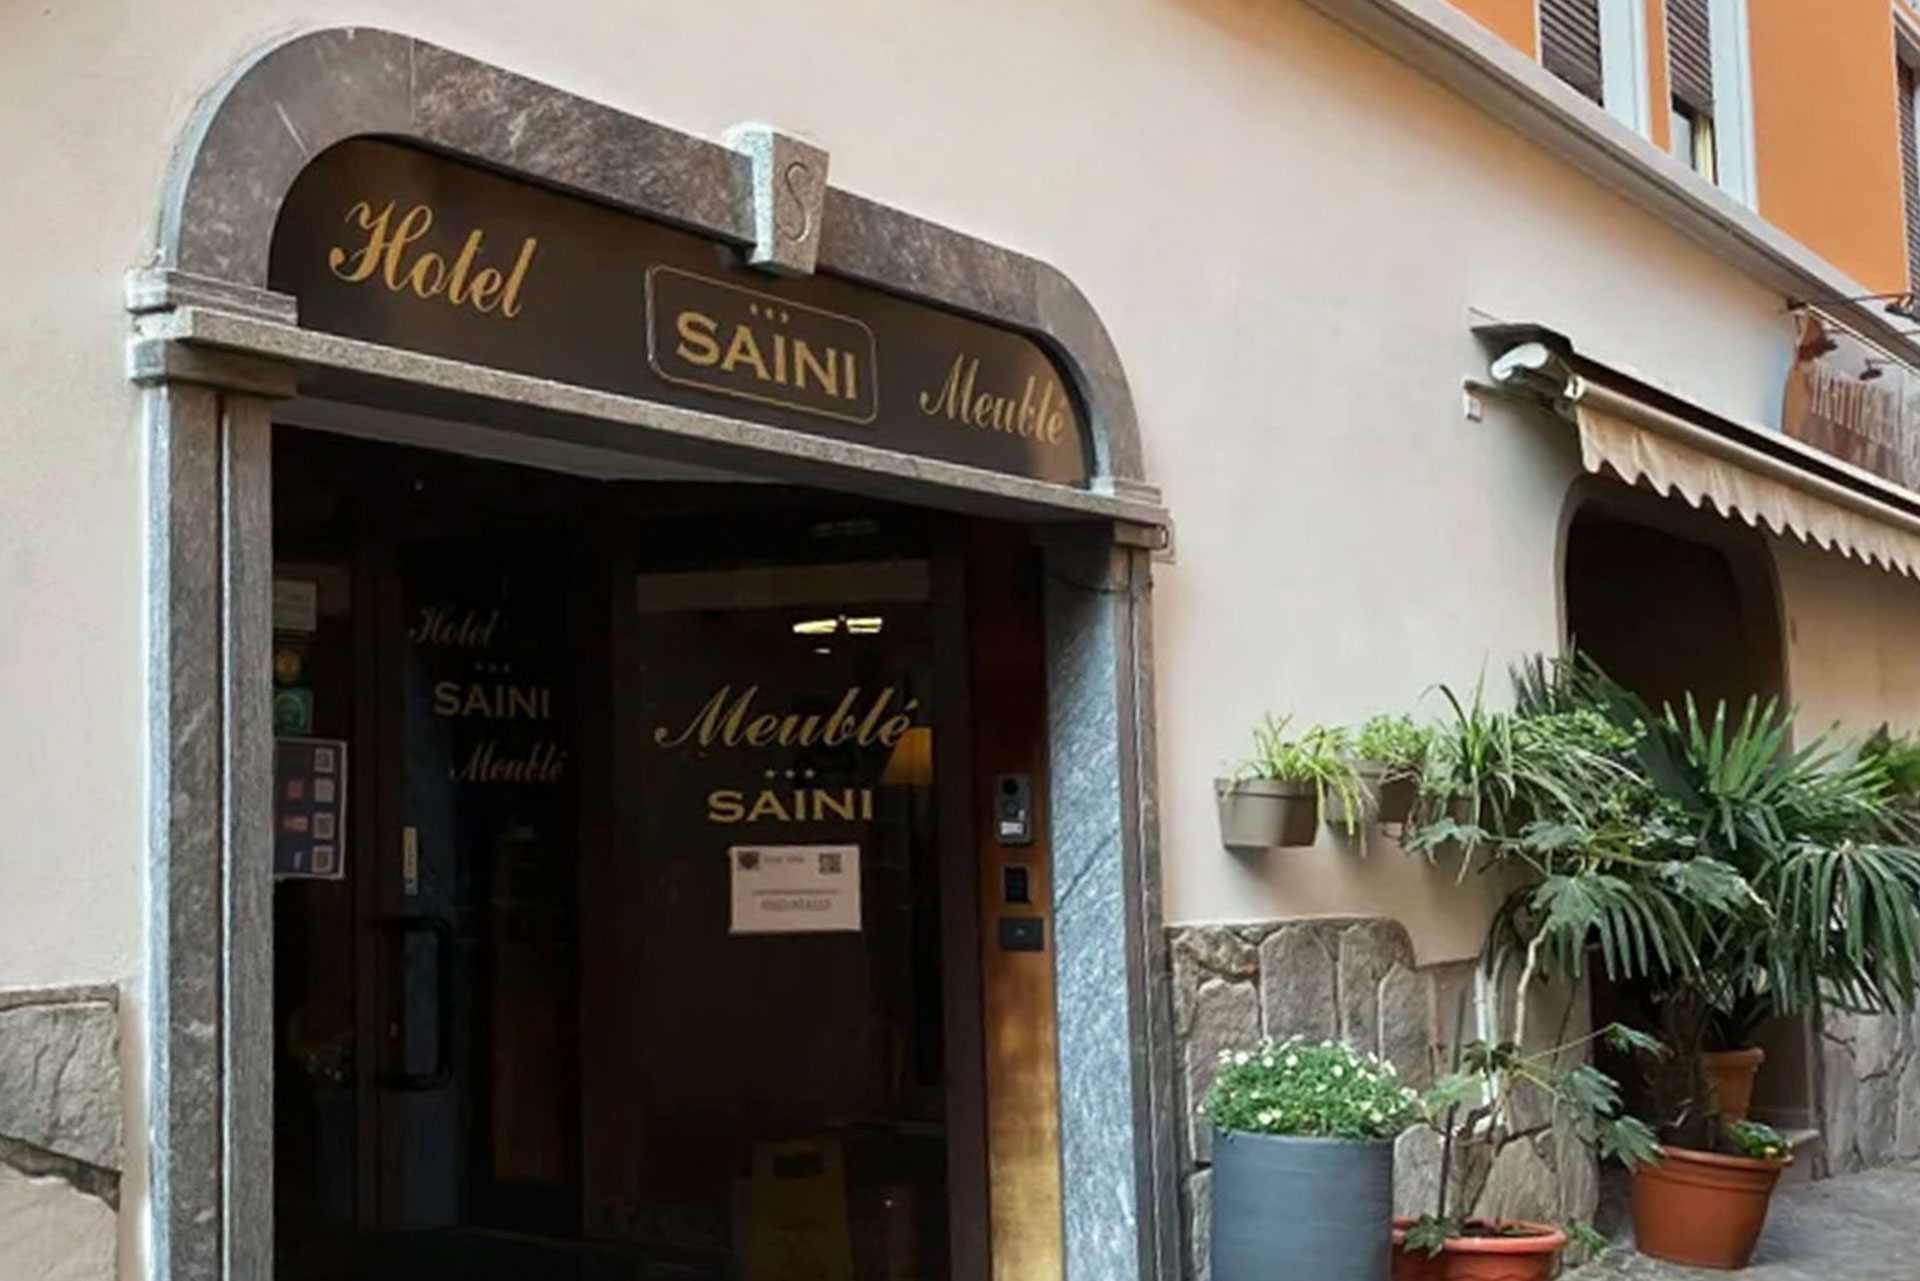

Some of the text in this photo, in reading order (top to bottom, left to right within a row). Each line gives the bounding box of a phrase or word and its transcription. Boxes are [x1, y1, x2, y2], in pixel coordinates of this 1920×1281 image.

[328, 199, 1068, 446] Hotel SAINI Meublé
[433, 680, 551, 720] SAINI
[653, 683, 919, 748] Meublé
[705, 786, 875, 824] SAINI
